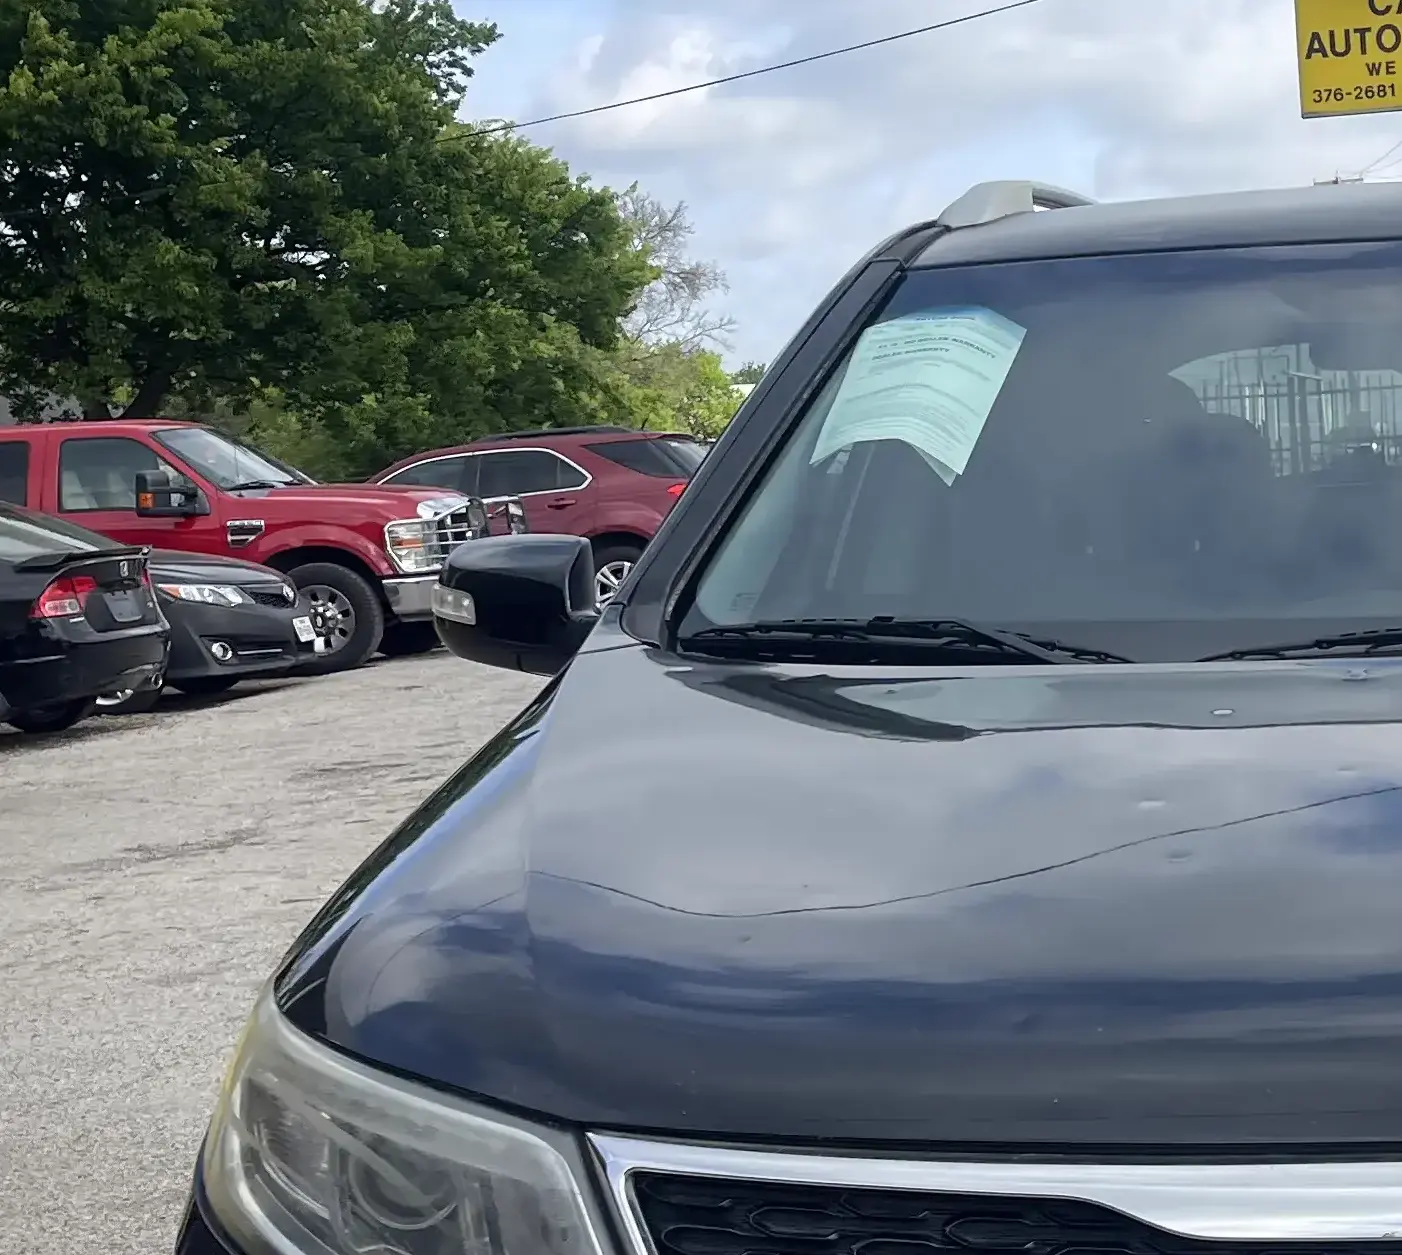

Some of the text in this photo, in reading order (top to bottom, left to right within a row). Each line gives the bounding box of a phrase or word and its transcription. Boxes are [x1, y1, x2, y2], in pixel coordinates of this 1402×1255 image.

[1305, 24, 1402, 59] AUTO
[1365, 61, 1397, 76] WE
[1312, 83, 1397, 104] 376-2681
